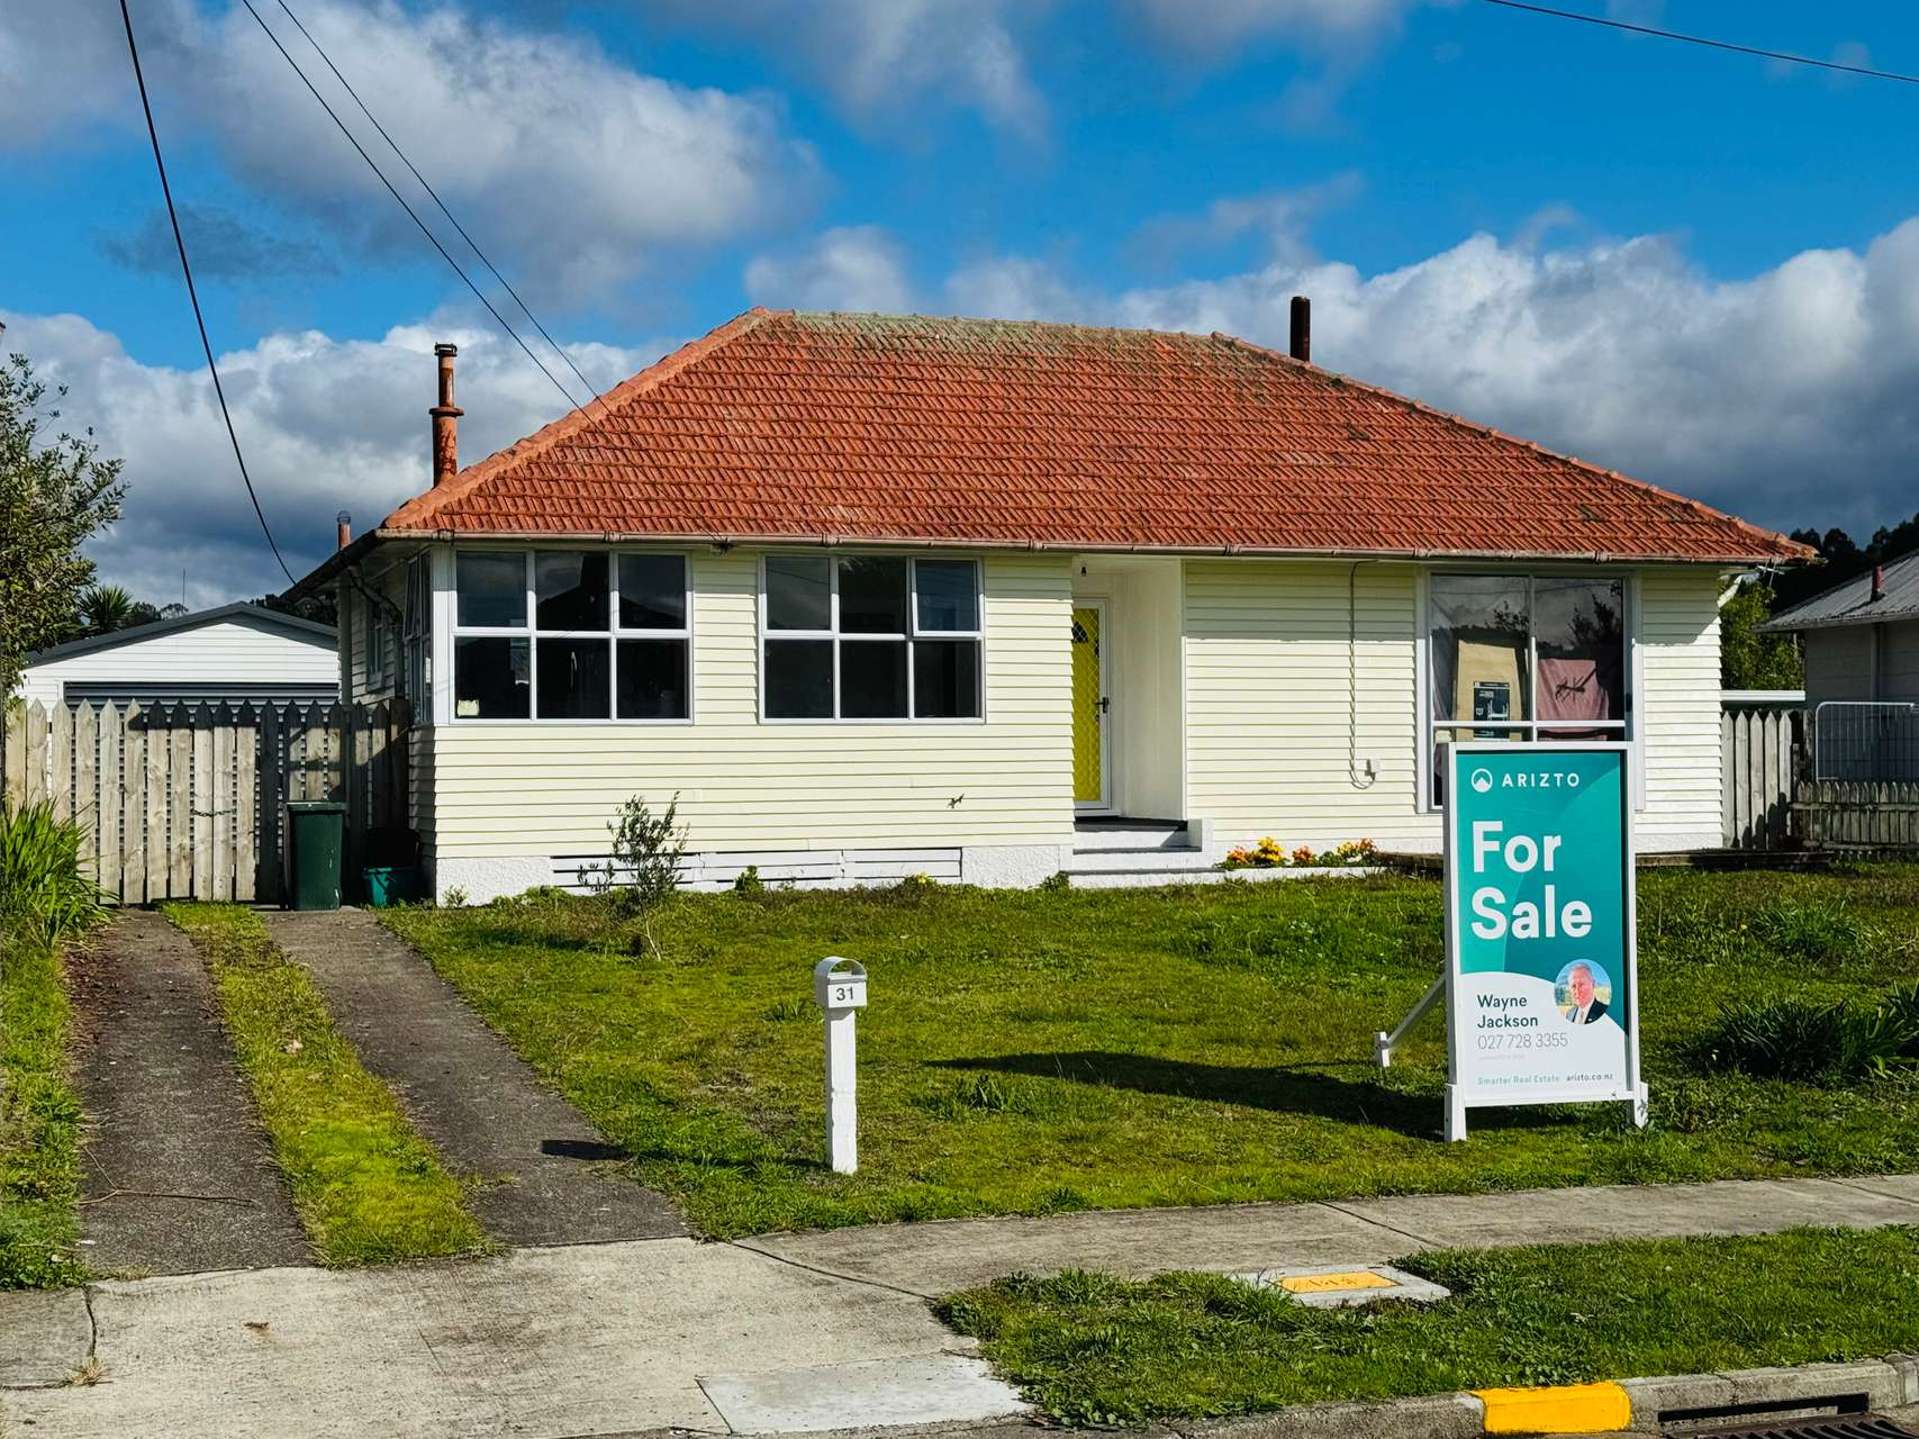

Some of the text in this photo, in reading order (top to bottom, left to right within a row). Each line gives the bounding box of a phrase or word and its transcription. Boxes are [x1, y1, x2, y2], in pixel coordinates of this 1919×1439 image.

[1502, 773, 1580, 788] ARIZTO
[1472, 821, 1562, 873] For
[1471, 884, 1593, 940] Sale
[836, 986, 854, 1001] 31
[1477, 994, 1528, 1011] Wayne
[1477, 1014, 1539, 1029] Jackson
[1477, 1032, 1569, 1050] 027 728 3355
[1477, 1076, 1511, 1085] Smarter
[1513, 1075, 1532, 1083] Real
[1533, 1074, 1560, 1083] Estate
